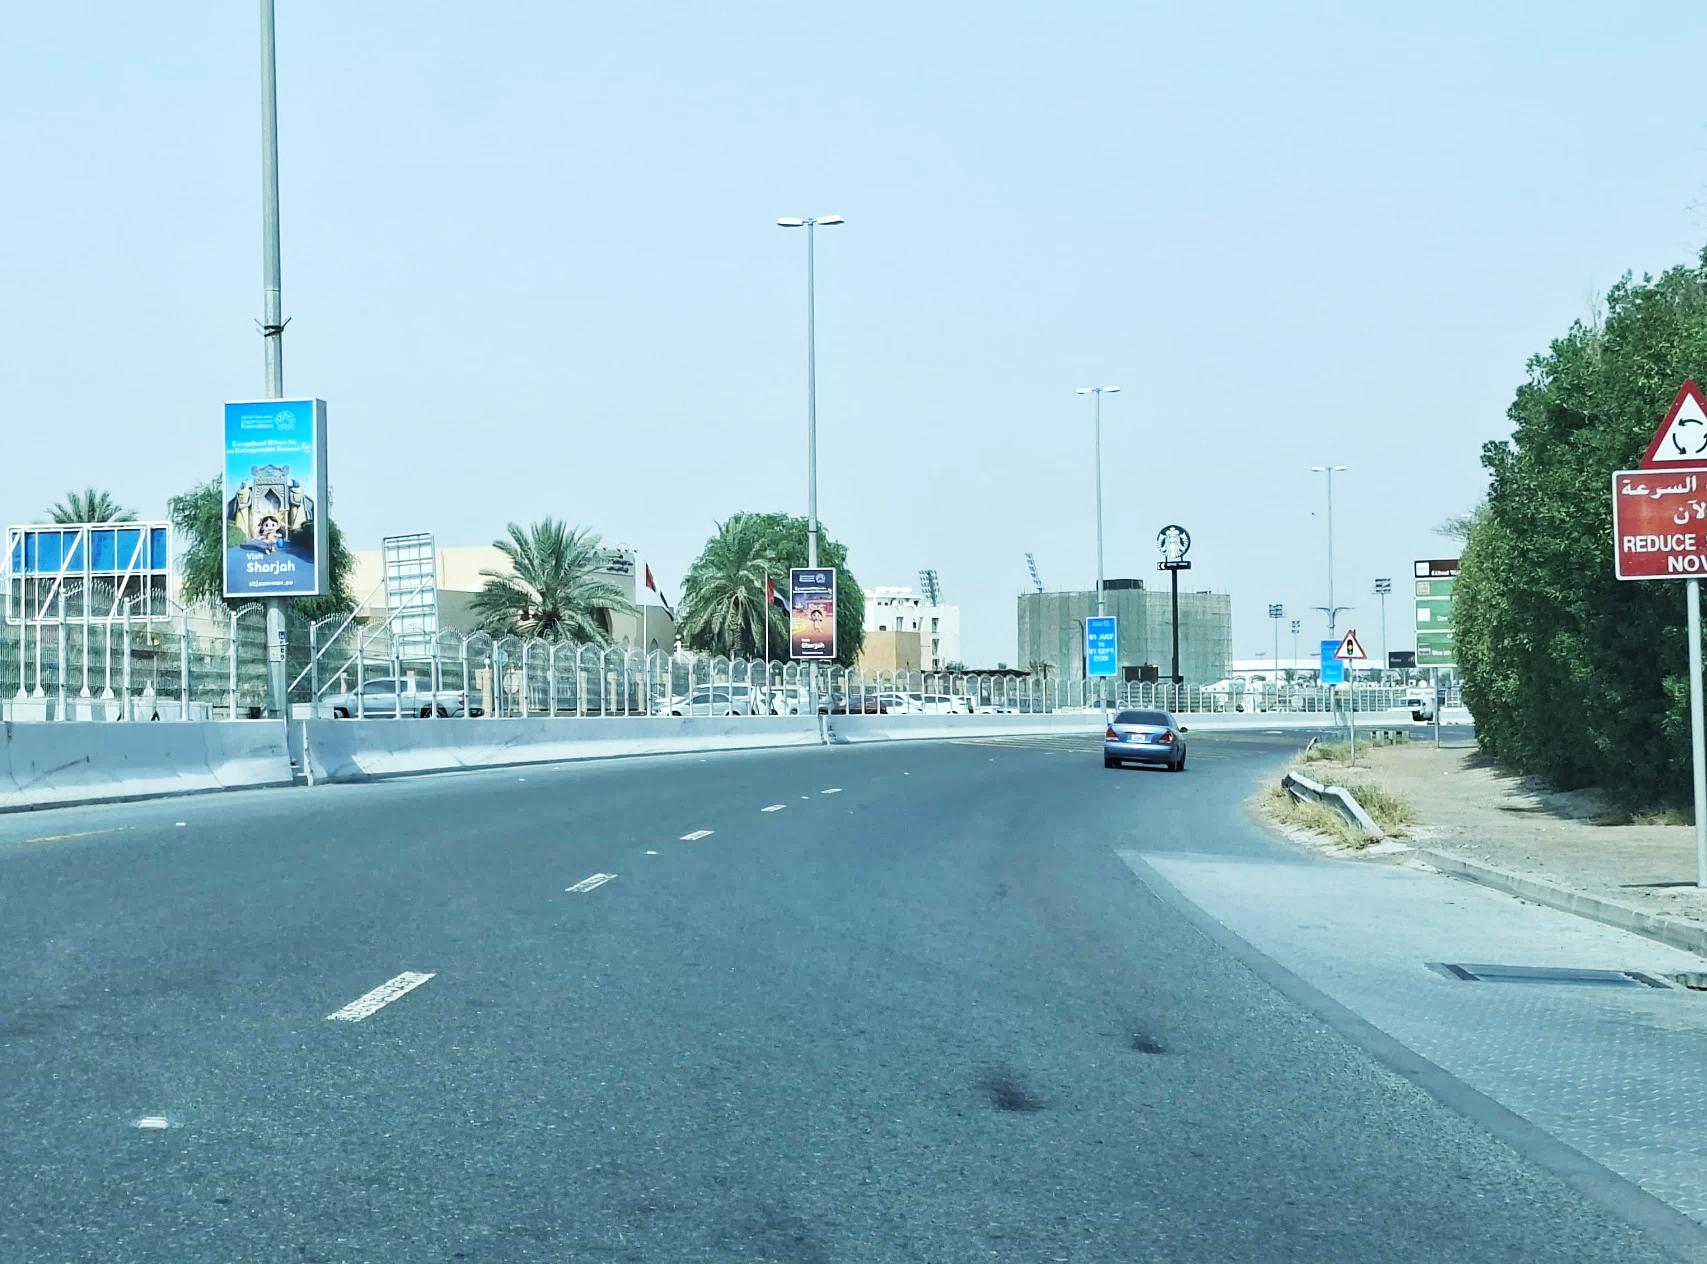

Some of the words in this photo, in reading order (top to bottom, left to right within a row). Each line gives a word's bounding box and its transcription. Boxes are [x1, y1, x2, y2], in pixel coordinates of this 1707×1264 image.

[1621, 475, 1697, 499] السرعة
[1623, 533, 1696, 553] REDUCE
[246, 560, 296, 575] Sharjah
